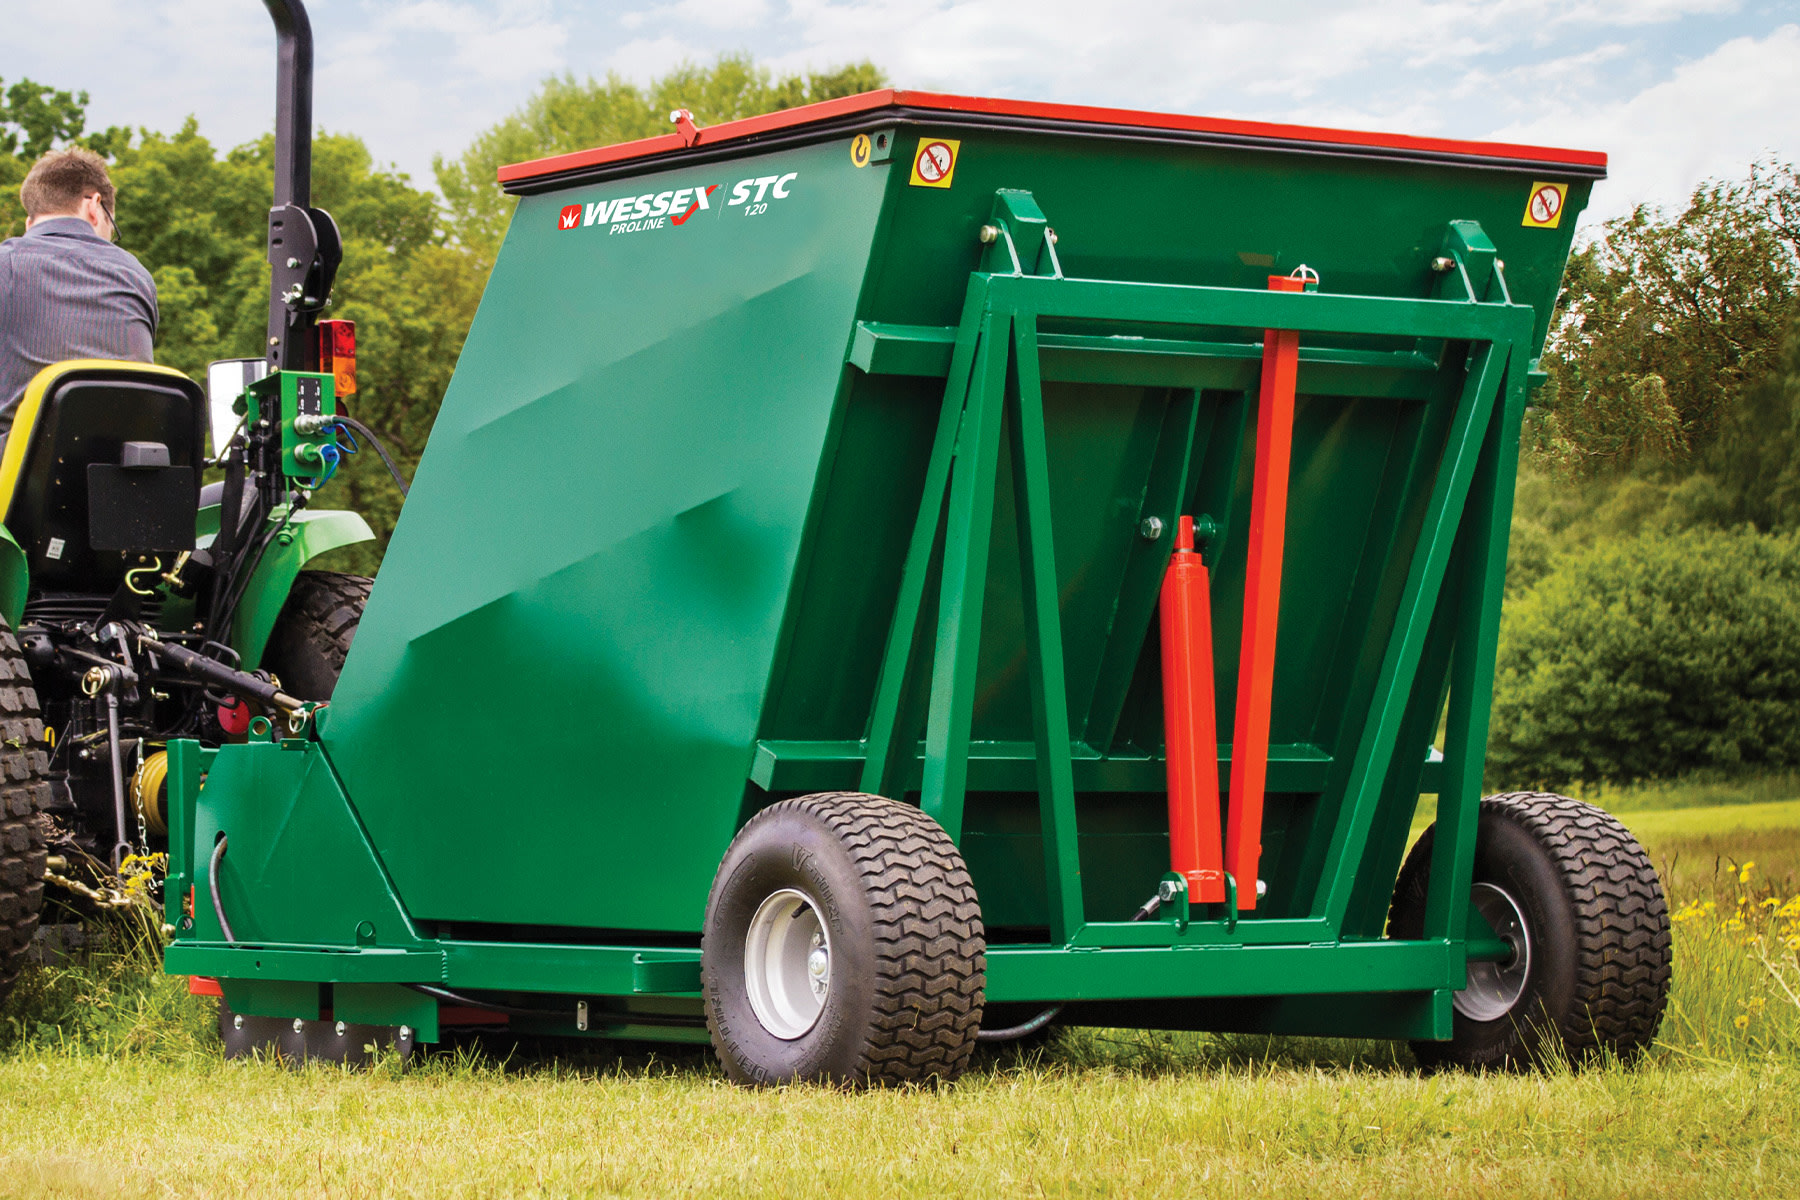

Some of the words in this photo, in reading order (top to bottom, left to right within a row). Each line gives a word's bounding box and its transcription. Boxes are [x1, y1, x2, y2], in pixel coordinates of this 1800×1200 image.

[583, 184, 719, 227] WESSEX
[727, 172, 798, 206] STC
[744, 202, 768, 217] 120
[609, 217, 666, 236] PROLINE
